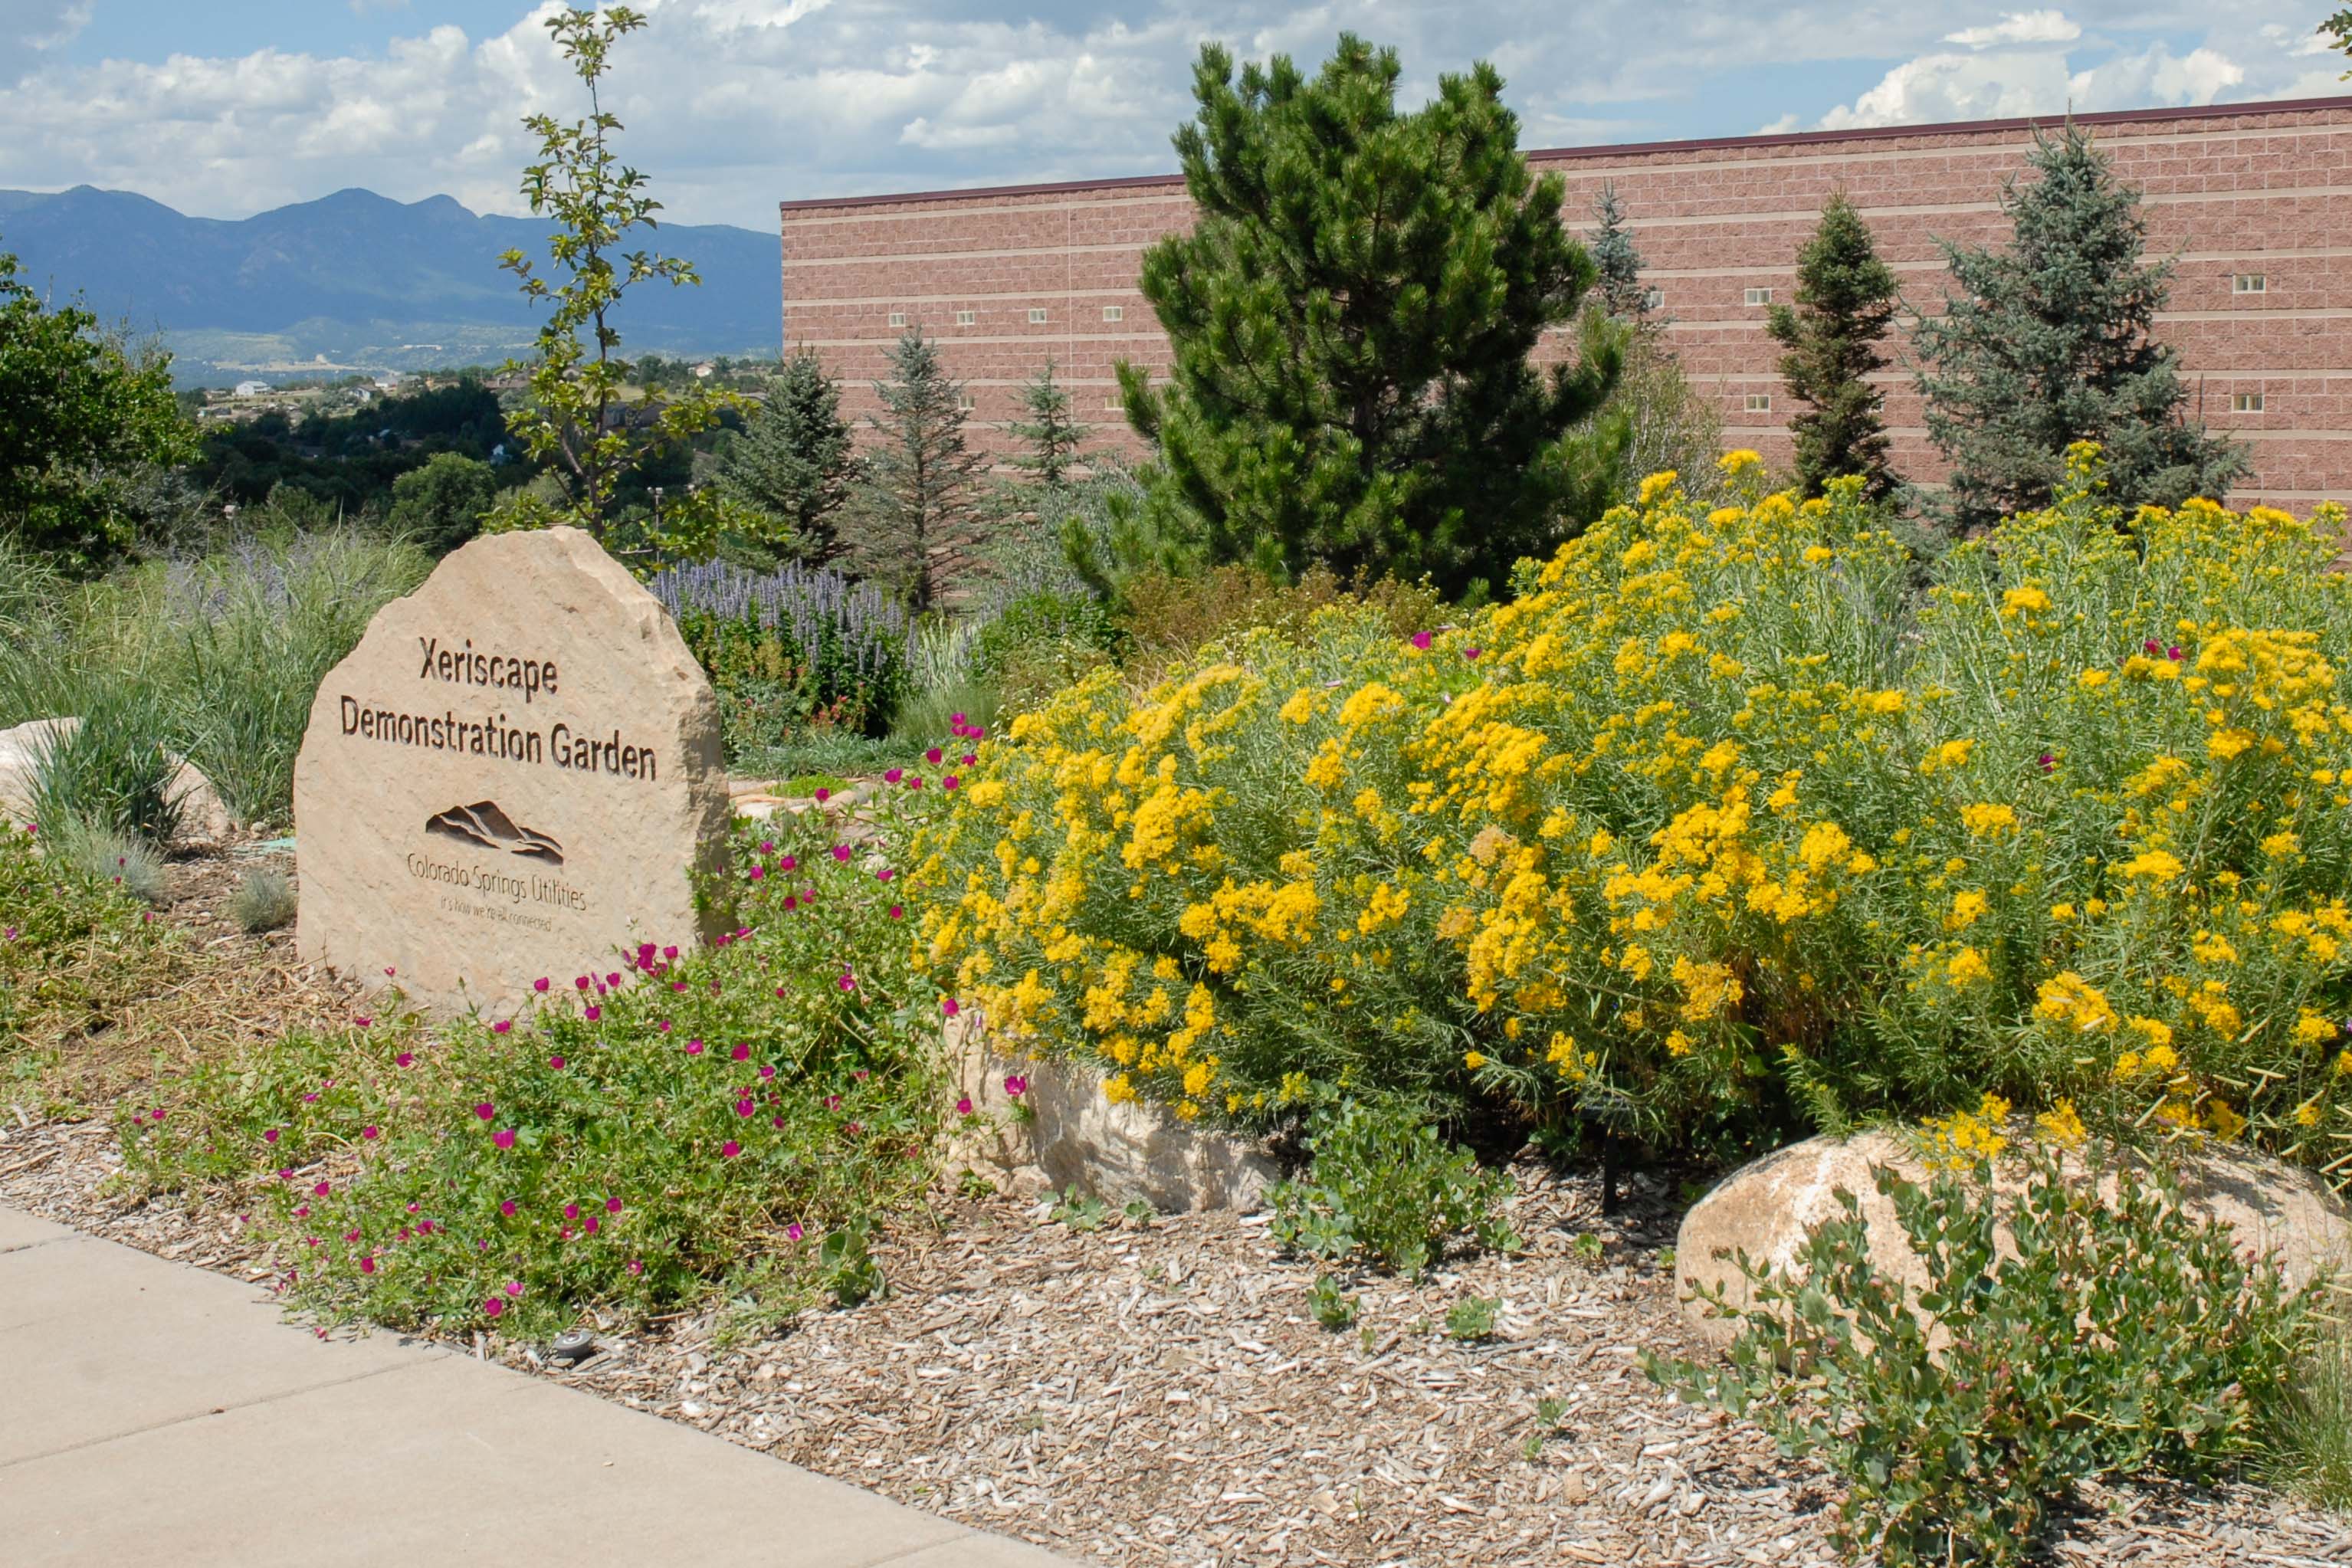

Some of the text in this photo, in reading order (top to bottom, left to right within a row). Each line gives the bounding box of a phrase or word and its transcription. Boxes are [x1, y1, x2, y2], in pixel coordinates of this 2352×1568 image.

[419, 636, 558, 704] Xeriscape
[341, 695, 656, 782] Demonstration Garden
[408, 852, 587, 911] Colorado Springs Utilities
